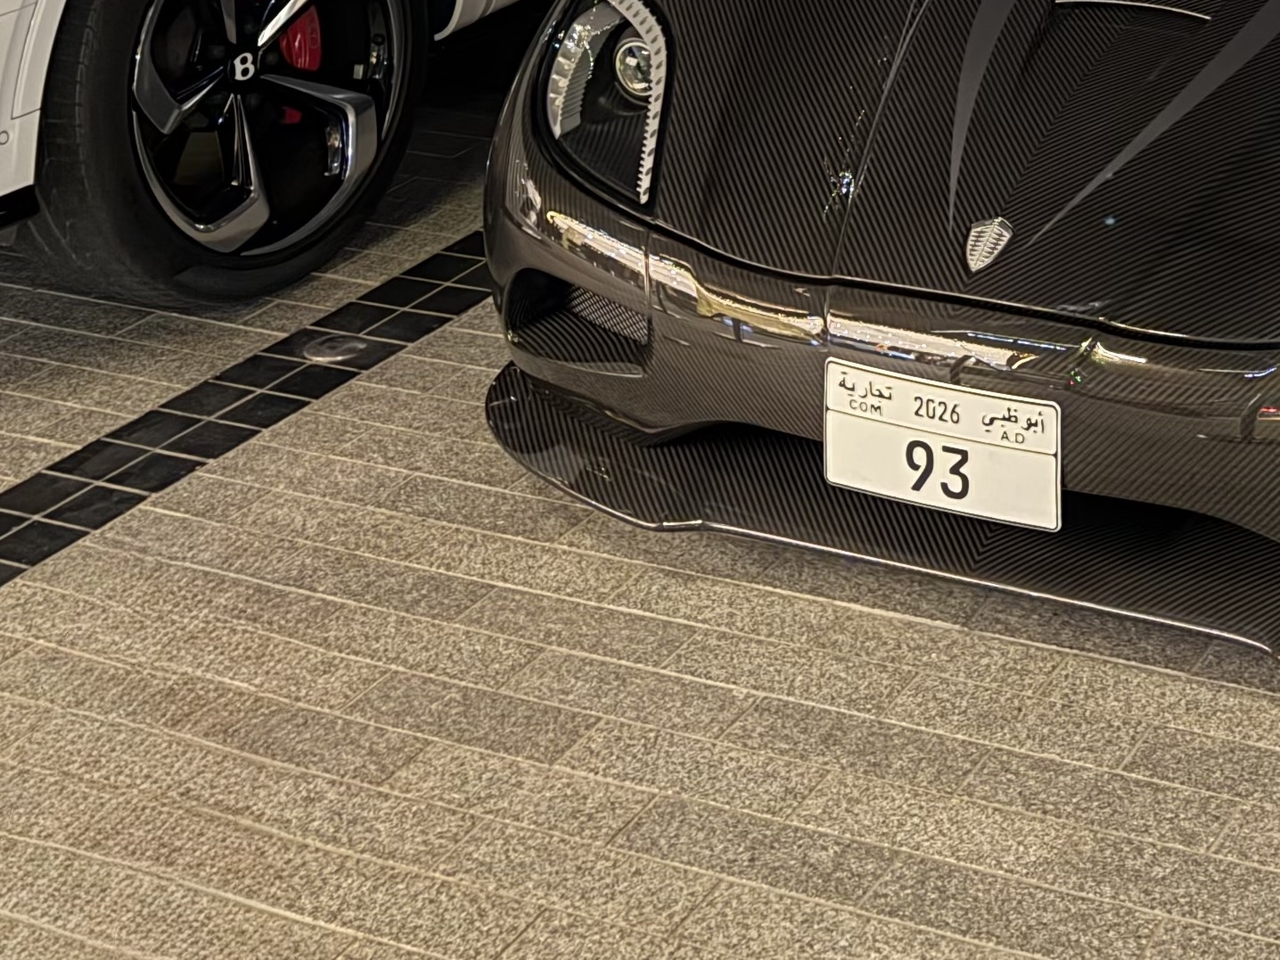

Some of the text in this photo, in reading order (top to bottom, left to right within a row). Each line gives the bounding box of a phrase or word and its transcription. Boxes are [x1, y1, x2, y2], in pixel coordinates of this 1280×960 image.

[233, 52, 255, 81] B
[838, 371, 893, 403] تجارية
[849, 398, 883, 417] COM
[914, 396, 960, 424] 2026
[905, 439, 970, 500] 93
